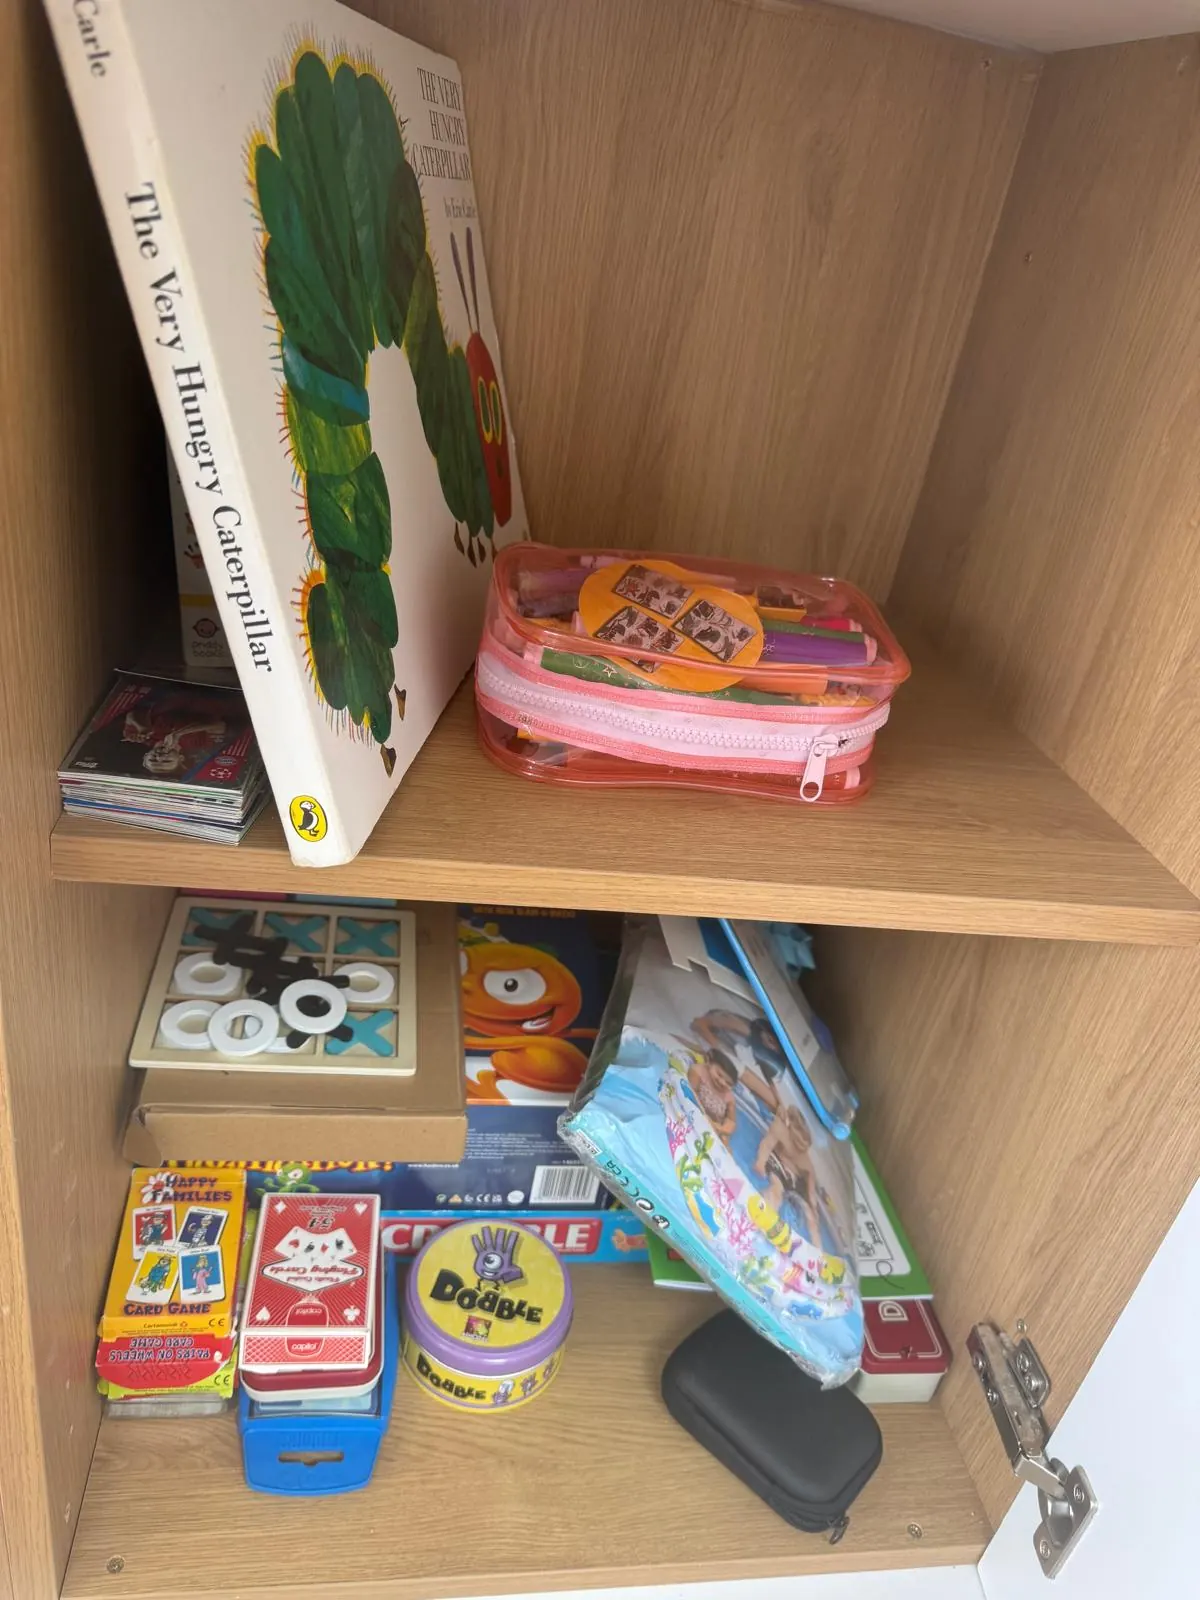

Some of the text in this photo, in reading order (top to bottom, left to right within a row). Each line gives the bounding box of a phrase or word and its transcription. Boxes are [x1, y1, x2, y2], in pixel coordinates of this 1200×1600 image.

[73, 0, 111, 79] Carle
[416, 66, 461, 112] THE VERY
[429, 109, 466, 147] HUNGRY
[411, 142, 471, 181] CATERPILLAR
[125, 181, 273, 673] The Very Hungry Caterpillar
[164, 1172, 218, 1189] HAPPY
[151, 1190, 233, 1203] FAMILIES
[123, 1302, 212, 1316] CARD GAME
[108, 1348, 211, 1361] PAIRS ON WHEELS
[129, 1337, 194, 1348] CARD GAME
